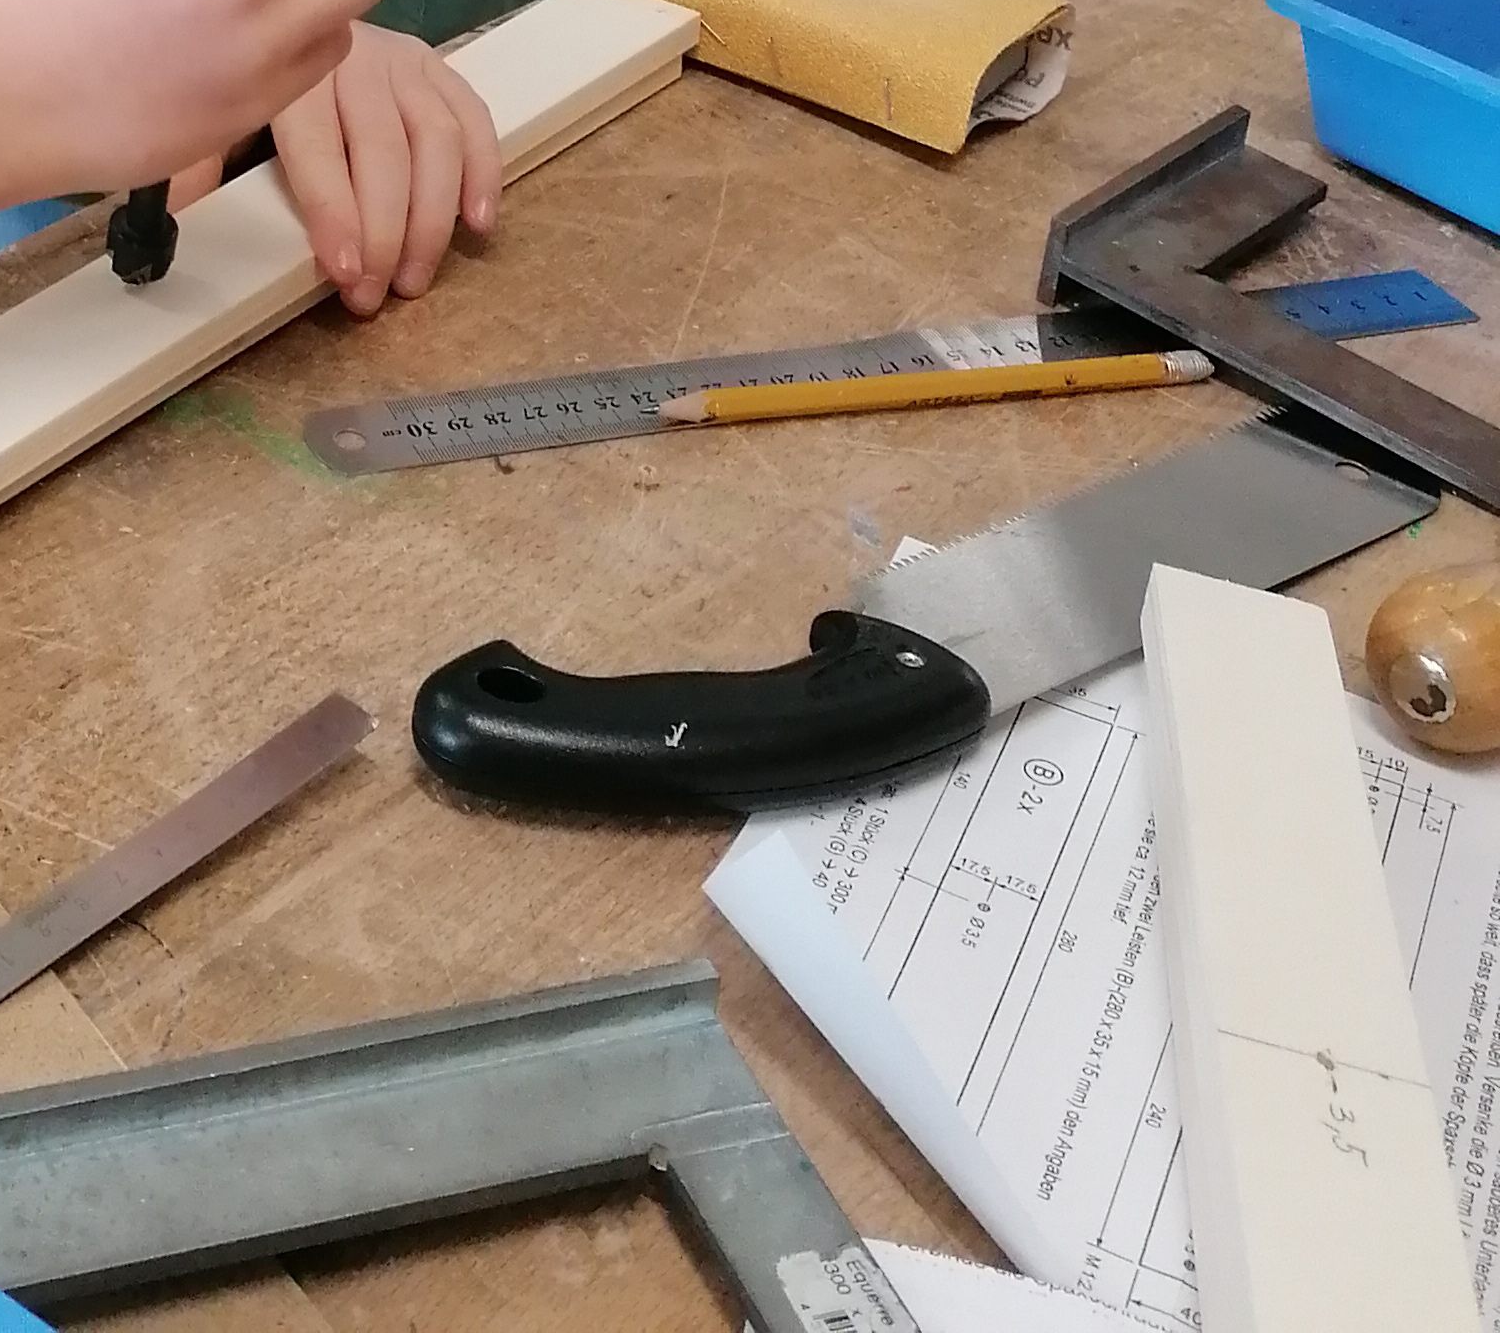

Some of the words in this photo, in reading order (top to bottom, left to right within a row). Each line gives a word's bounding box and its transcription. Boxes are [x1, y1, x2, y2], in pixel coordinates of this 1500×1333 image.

[980, 345, 1003, 357] 14
[1014, 340, 1038, 353] 13
[556, 400, 584, 415] 26
[594, 396, 622, 412] 25
[631, 391, 658, 406] 24
[484, 410, 513, 426] 28
[523, 405, 549, 421] 27
[406, 420, 438, 439] 30
[447, 416, 475, 432] 29
[951, 769, 971, 790] 140
[857, 812, 885, 847] Stück
[823, 833, 847, 857] (G)
[845, 842, 870, 866] (C)
[810, 870, 830, 889] 40
[1125, 864, 1145, 881] 12
[829, 878, 853, 905] 300
[1117, 878, 1138, 903] mm
[1136, 895, 1161, 926] zwei
[1055, 928, 1080, 955] 280
[1120, 923, 1150, 969] Leisten
[1475, 950, 1497, 980] dass
[1462, 980, 1491, 1022] später
[1098, 1017, 1113, 1029] x
[1462, 1022, 1483, 1043] die
[1091, 1028, 1112, 1049] 35
[1086, 1046, 1103, 1059] x
[1080, 1059, 1101, 1079] 15
[1064, 1075, 1096, 1111] mm)
[1449, 1085, 1470, 1108] der
[1059, 1108, 1084, 1138] den
[1144, 1102, 1167, 1129] 240
[1468, 1137, 1489, 1160] die
[1032, 1134, 1074, 1203] Angaben
[1462, 1175, 1483, 1188] 3
[1083, 1252, 1101, 1268] M
[822, 1259, 853, 1298] 300
[842, 1256, 897, 1331] Equerre
